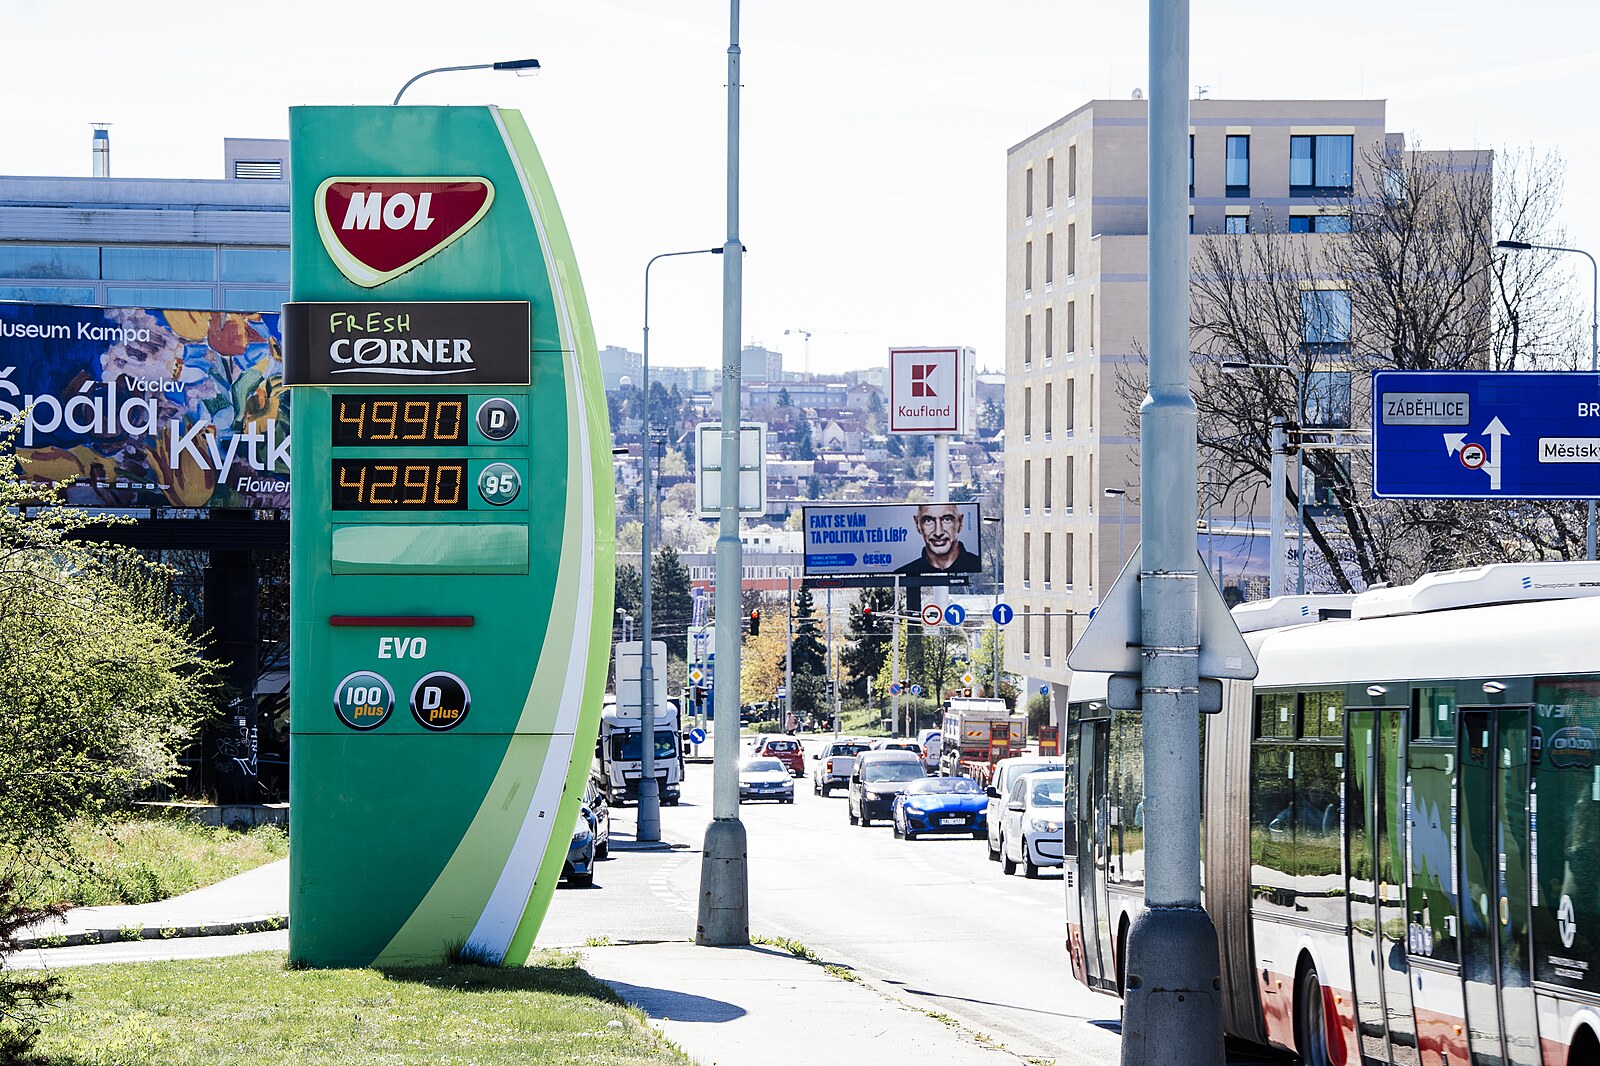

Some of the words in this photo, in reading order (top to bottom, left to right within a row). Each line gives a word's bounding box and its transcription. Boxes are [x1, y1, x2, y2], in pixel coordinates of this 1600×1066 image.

[341, 192, 435, 230] MOL
[0, 319, 71, 339] useum
[77, 321, 150, 345] Kampa
[329, 312, 411, 334] FRESH
[124, 377, 186, 393] Václav
[898, 405, 951, 417] Kaufland
[1387, 398, 1465, 417] ZÁBĚHLICE
[1578, 402, 1600, 417] BR
[339, 401, 462, 440] 49.90
[490, 409, 505, 429] D
[1544, 443, 1600, 461] Městsk
[339, 465, 462, 504] 42.90
[486, 474, 514, 495] 95
[810, 514, 832, 529] FAKT
[834, 514, 846, 528] SE
[846, 512, 867, 528] VÁM
[811, 530, 823, 544] TA
[823, 529, 865, 544] POLITIKA
[865, 528, 885, 543] TEĎ
[884, 527, 908, 543] LÍBÍ?
[862, 552, 892, 566] ČESKO
[377, 637, 428, 660] EVO
[346, 686, 382, 706] 100
[422, 686, 442, 710] D
[353, 704, 384, 719] plus
[429, 706, 460, 722] plus
